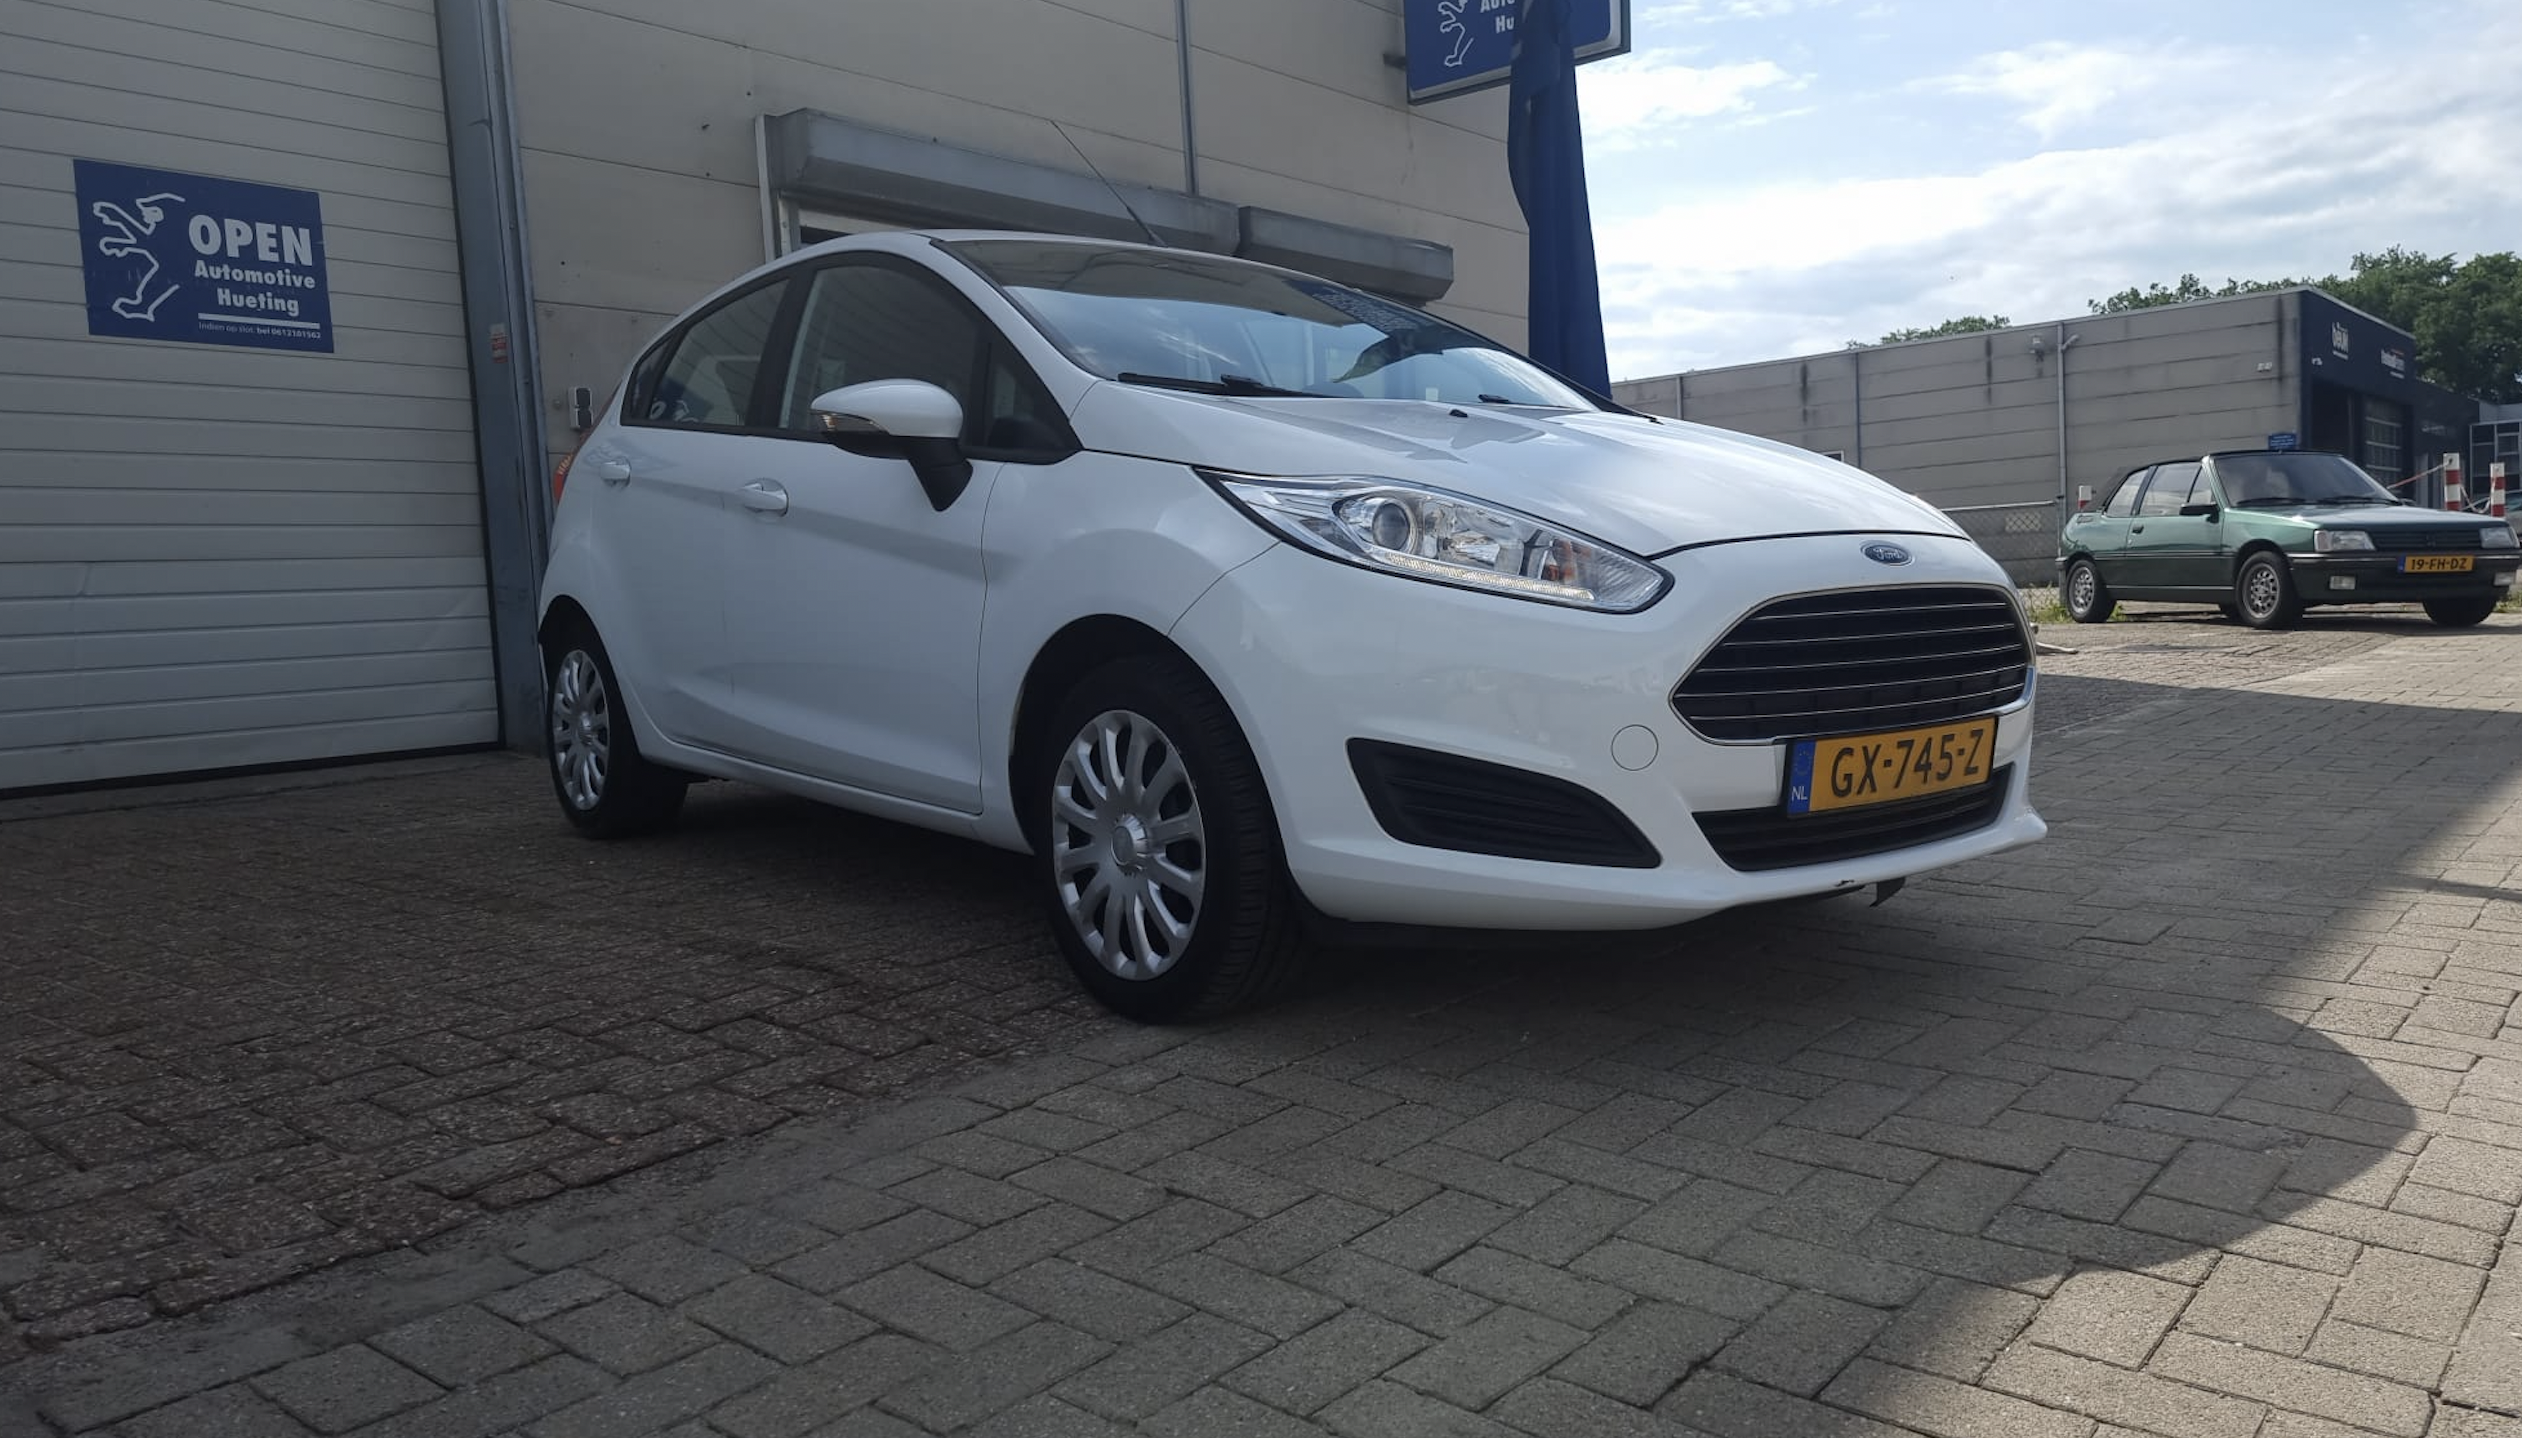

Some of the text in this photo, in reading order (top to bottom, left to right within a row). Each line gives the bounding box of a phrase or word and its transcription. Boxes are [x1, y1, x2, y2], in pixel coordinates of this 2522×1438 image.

[188, 214, 313, 267] OPEN
[194, 259, 316, 289] Automotive
[217, 287, 300, 317] Hueting
[2411, 557, 2468, 571] 19-FH-DZ
[1831, 728, 1984, 798] GX-745-Z
[1791, 785, 1809, 802] NL
